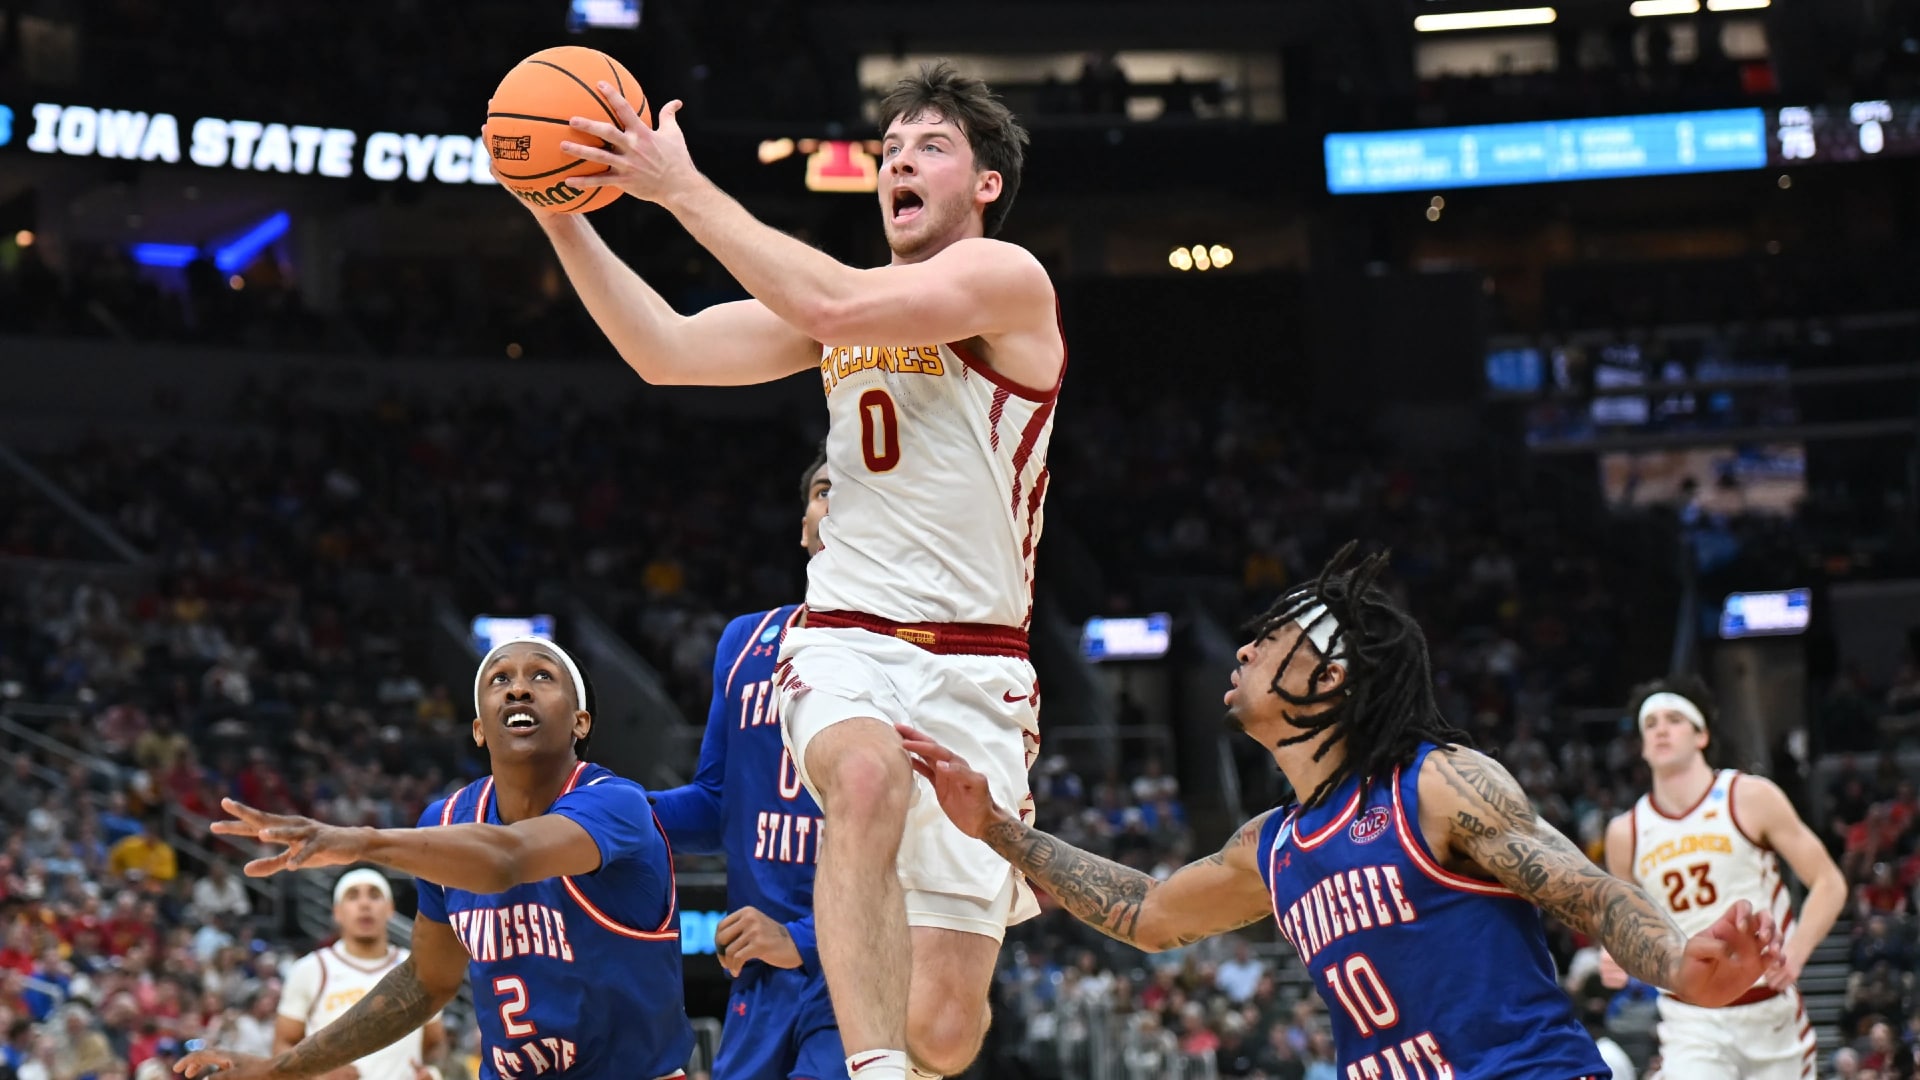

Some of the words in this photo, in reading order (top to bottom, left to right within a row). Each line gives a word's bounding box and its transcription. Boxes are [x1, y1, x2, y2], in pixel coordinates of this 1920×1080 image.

[27, 102, 181, 164] IOWA
[189, 117, 357, 178] STATE
[820, 345, 945, 399] CYCLONES
[859, 386, 901, 475] 0
[1358, 814, 1386, 837] OVC
[1457, 810, 1498, 839] The
[1283, 865, 1418, 965] TENNESSEE
[1662, 861, 1719, 913] 23
[449, 903, 575, 963] TENNESSEE
[492, 974, 539, 1040] 2
[1323, 952, 1399, 1039] 10
[492, 1037, 577, 1080] STATE
